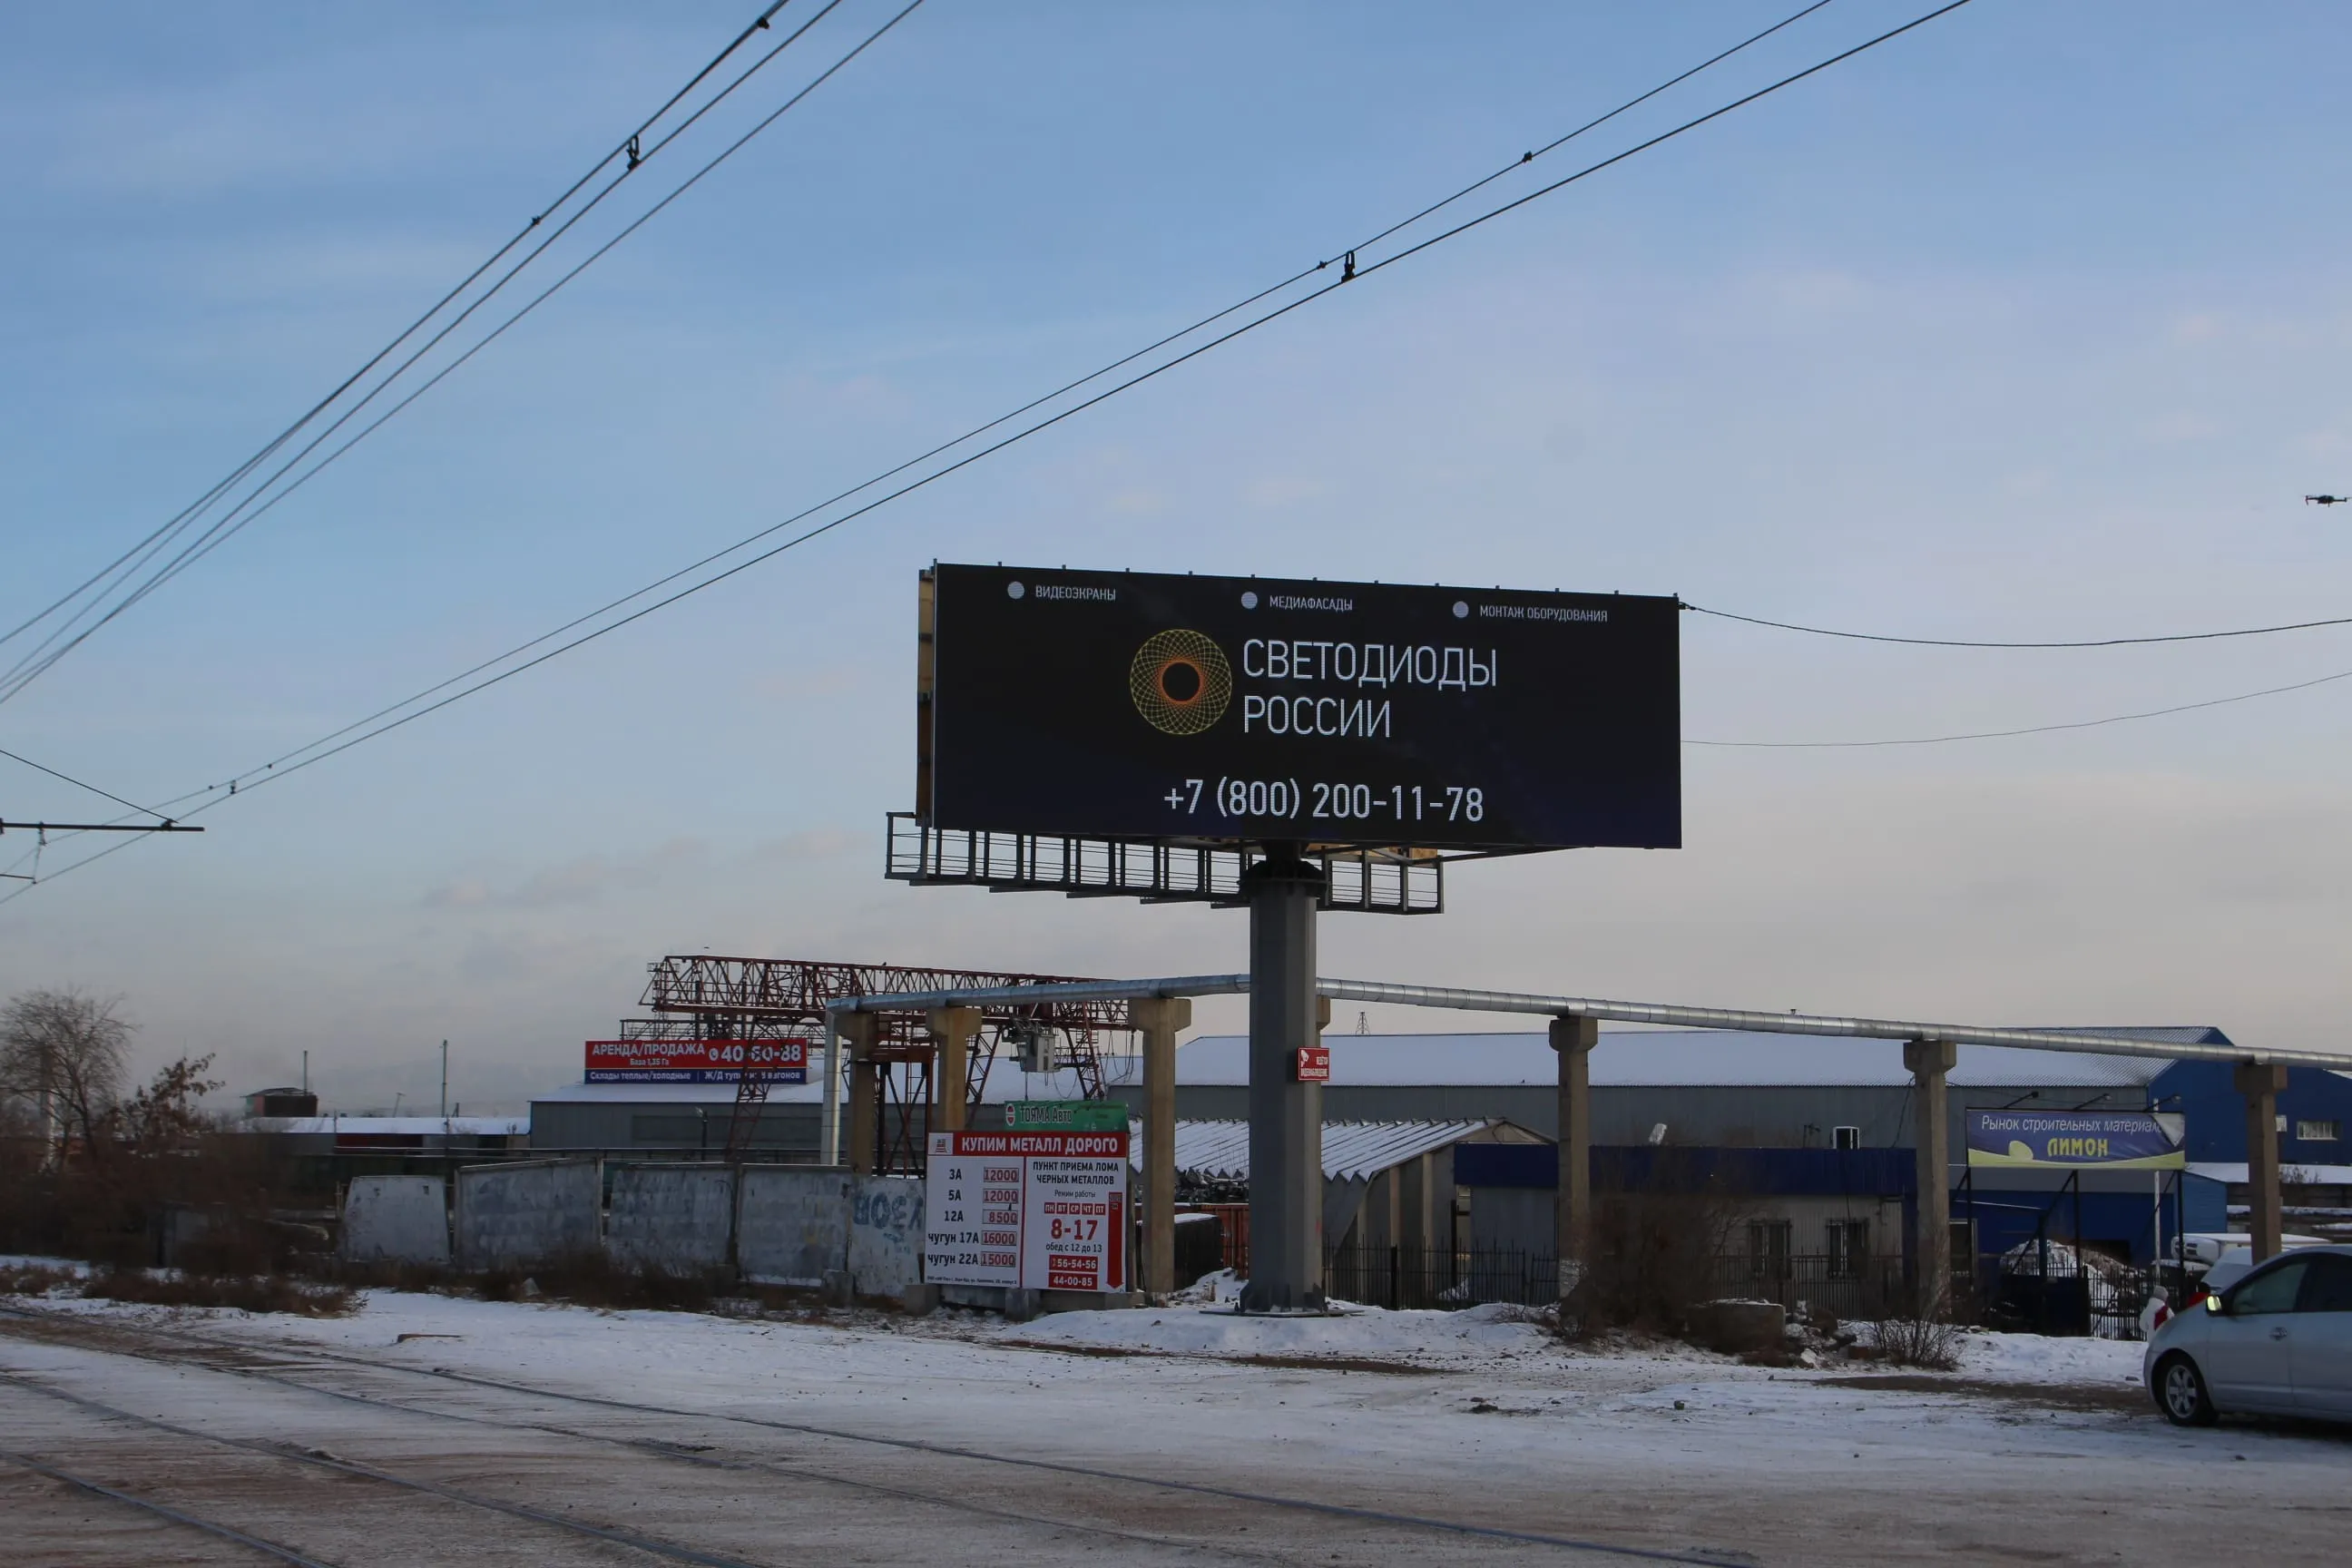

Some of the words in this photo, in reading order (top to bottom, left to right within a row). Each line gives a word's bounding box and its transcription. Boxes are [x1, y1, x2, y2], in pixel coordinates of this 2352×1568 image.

[1034, 585, 1116, 601] ВИДЕОЭКРАНЫ
[1269, 595, 1353, 612] МЕДИАФАСАДЫ
[1480, 605, 1524, 618] МОНТАЖ
[1526, 606, 1608, 623] ОБОРУДОВАНИЯ
[1243, 638, 1496, 692] СВЕТОДИОДЫ
[1244, 695, 1390, 738] РОССИИ
[1163, 779, 1204, 814] +7
[1216, 776, 1300, 818] (800)
[1312, 783, 1484, 821] 200-11-78
[592, 1044, 706, 1056] АРЕНДА/ПРОДАЖА
[1981, 1115, 2020, 1131] Рынок
[2023, 1118, 2101, 1133] строительных
[961, 1137, 1006, 1152] КУПИМ
[1010, 1137, 1062, 1152] МЕТАЛЛ
[1064, 1137, 1119, 1155] ДОРОГО
[2046, 1138, 2109, 1157] ЛИМОН
[1033, 1161, 1058, 1171] ПУНКТ
[1060, 1161, 1093, 1171] ПРИЕМА
[1095, 1161, 1119, 1172] ЛОМА
[984, 1169, 1017, 1181] 12000
[1036, 1174, 1070, 1184] ЧЕРНЫХ
[1071, 1174, 1114, 1185] МЕТАЛЛОВ
[948, 1189, 962, 1201] 5А
[984, 1190, 1018, 1202] 12000
[1074, 1190, 1096, 1199] работы
[944, 1210, 964, 1222] 12А
[988, 1211, 1018, 1224] 8500
[1051, 1218, 1099, 1241] 8-17
[927, 1233, 956, 1246] чугун
[959, 1231, 980, 1244] 17А
[983, 1232, 1015, 1244] 16000
[1045, 1242, 1063, 1253] обед
[1071, 1243, 1080, 1252] 12
[1081, 1244, 1092, 1254] до
[1093, 1243, 1102, 1253] 13
[926, 1254, 956, 1267] чугун
[958, 1253, 979, 1265] 22А
